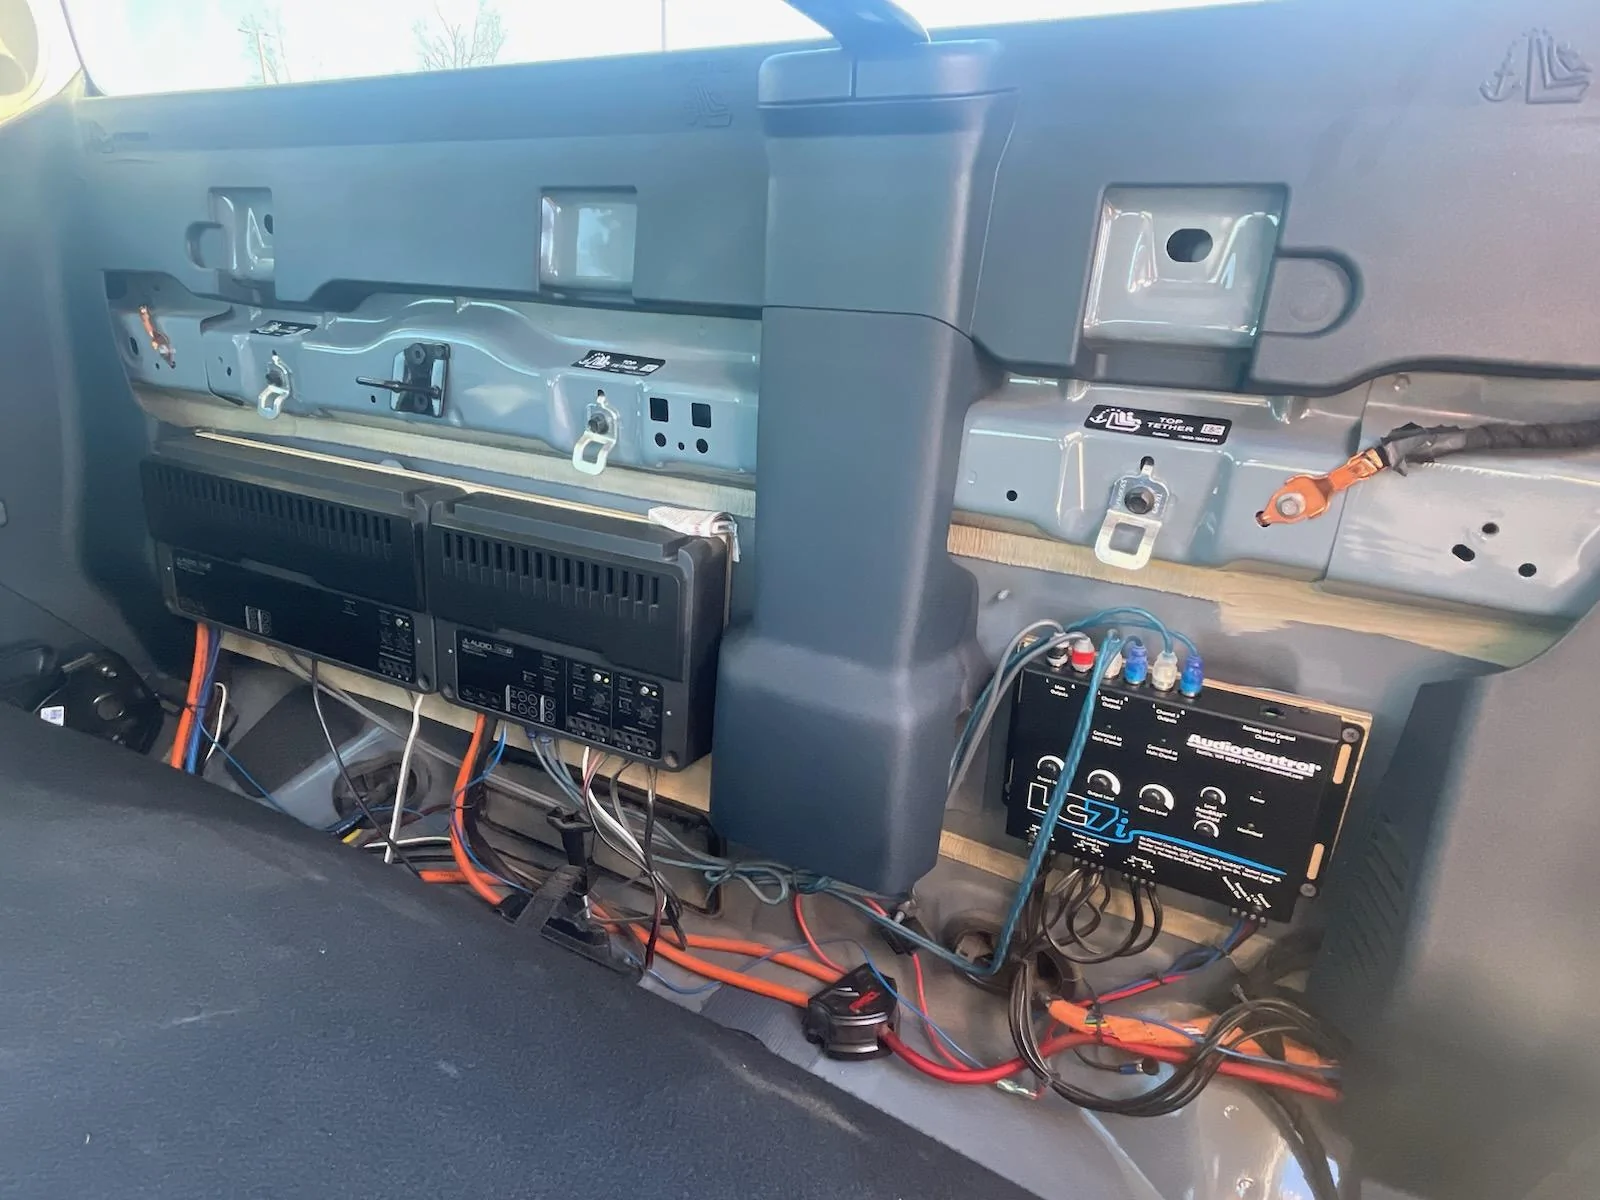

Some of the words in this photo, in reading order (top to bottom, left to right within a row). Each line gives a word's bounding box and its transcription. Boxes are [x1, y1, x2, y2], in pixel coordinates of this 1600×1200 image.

[1159, 416, 1184, 425] TOP
[1147, 421, 1195, 433] TETHER
[470, 639, 493, 650] AUDIO
